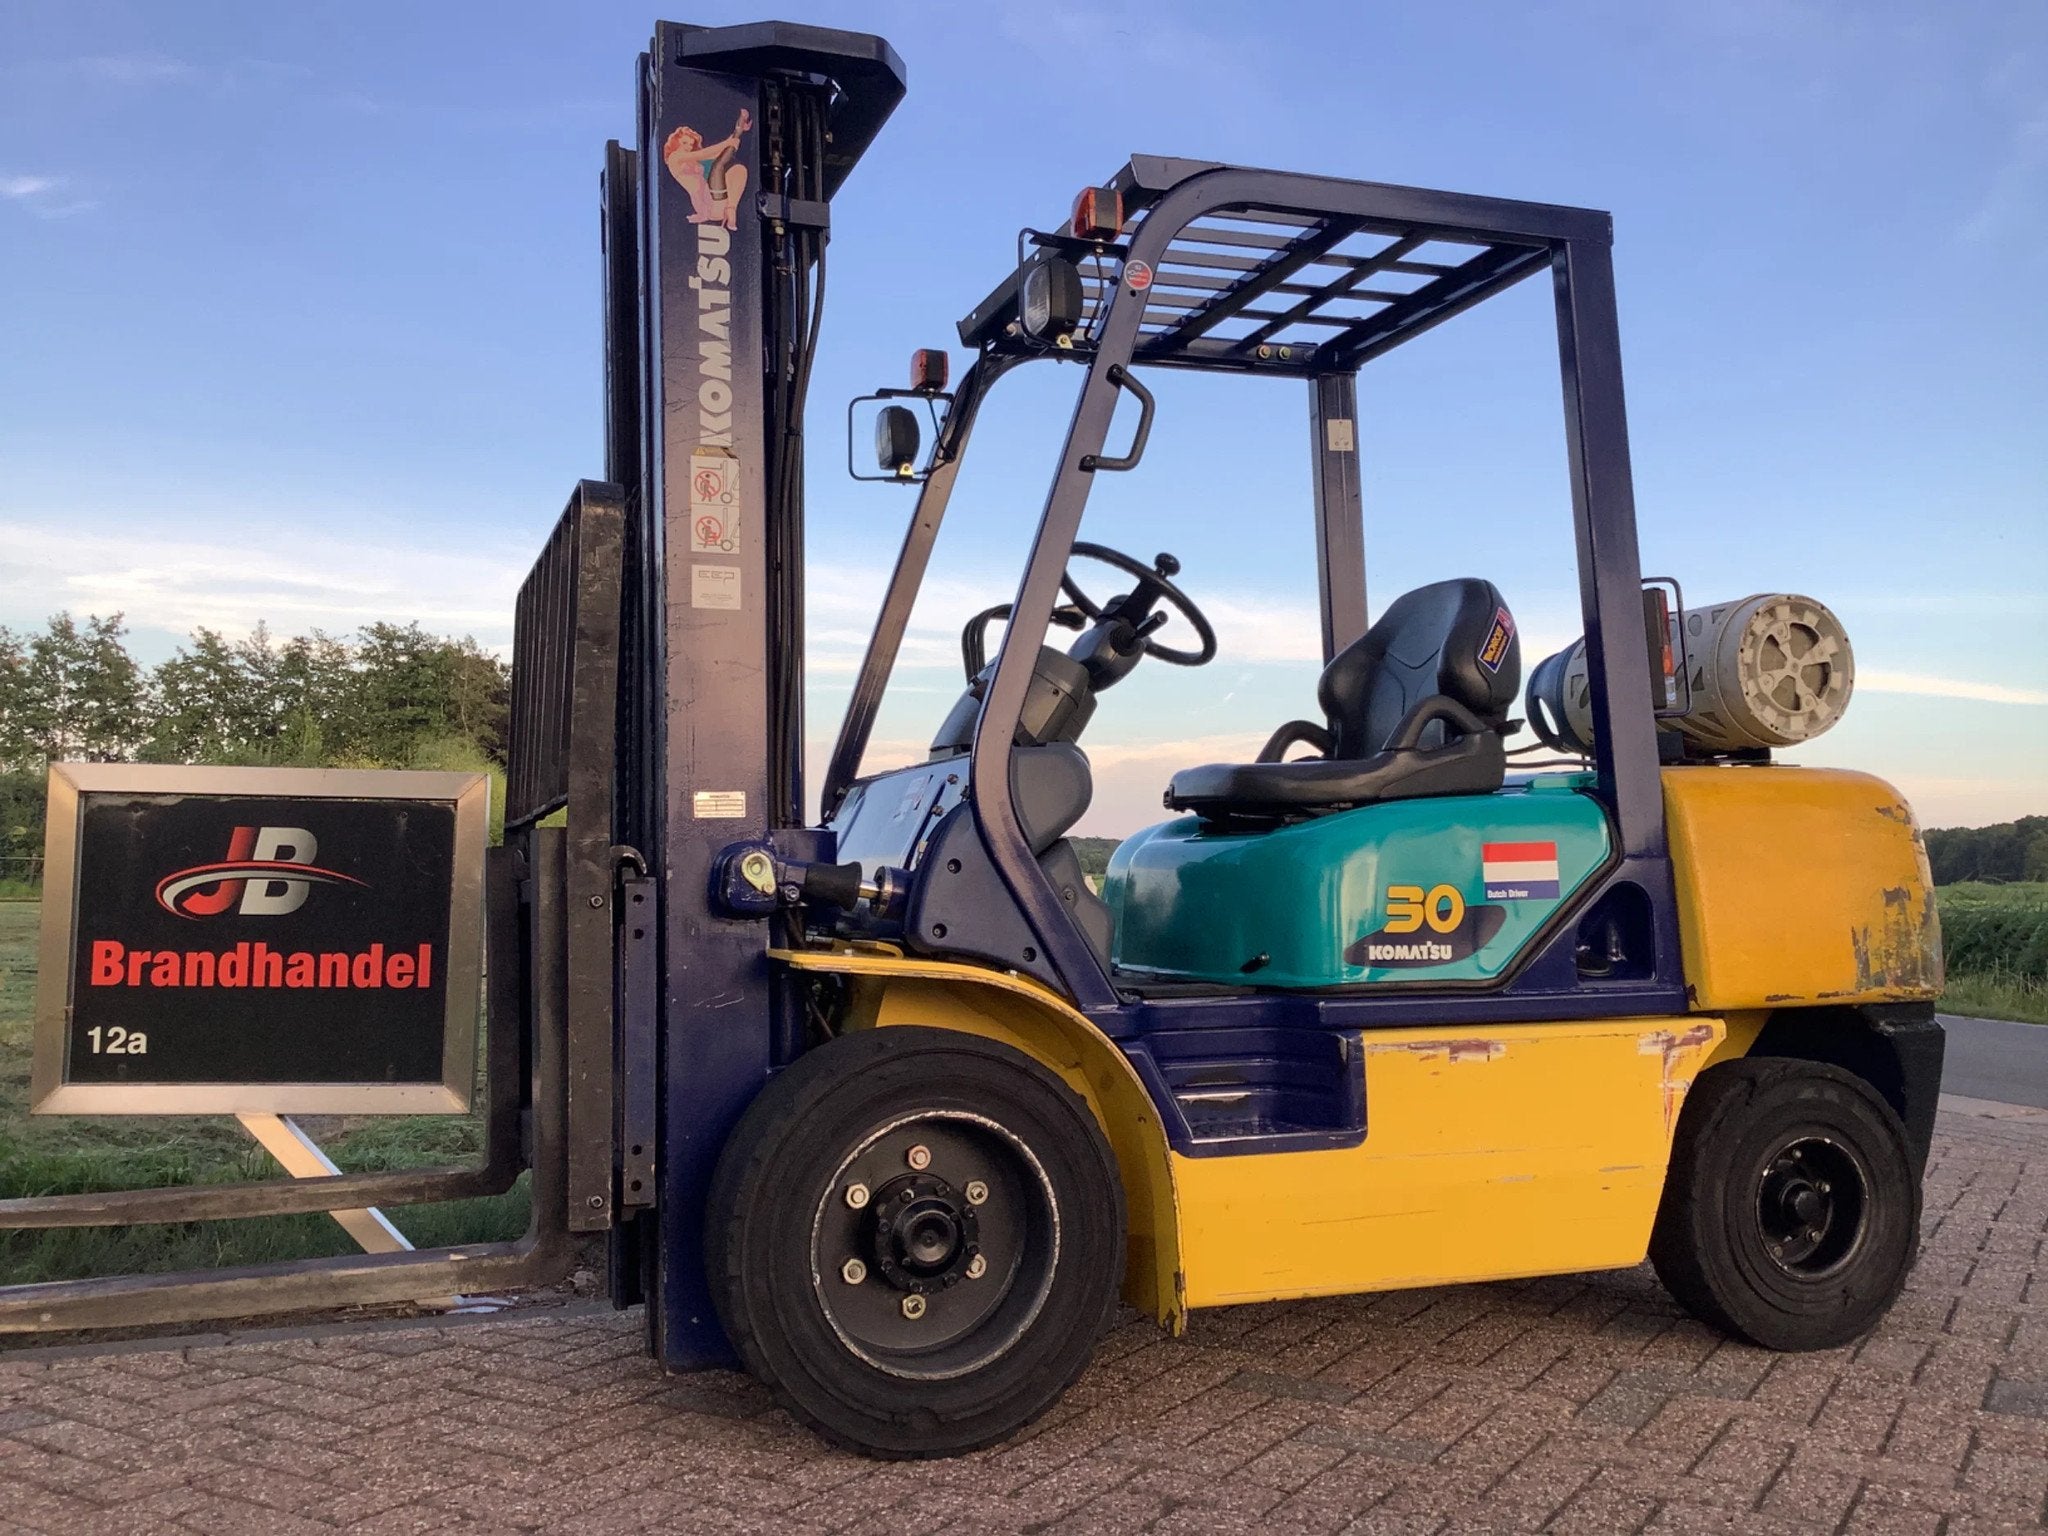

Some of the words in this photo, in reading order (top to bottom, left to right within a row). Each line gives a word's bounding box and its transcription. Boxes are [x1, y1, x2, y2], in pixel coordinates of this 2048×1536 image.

[688, 223, 733, 448] KOMATSU
[181, 825, 319, 916] JB
[1383, 884, 1466, 934] 30
[90, 939, 433, 989] Brandhandel
[1368, 940, 1453, 961] KOMATSU
[87, 1026, 148, 1055] 12a
